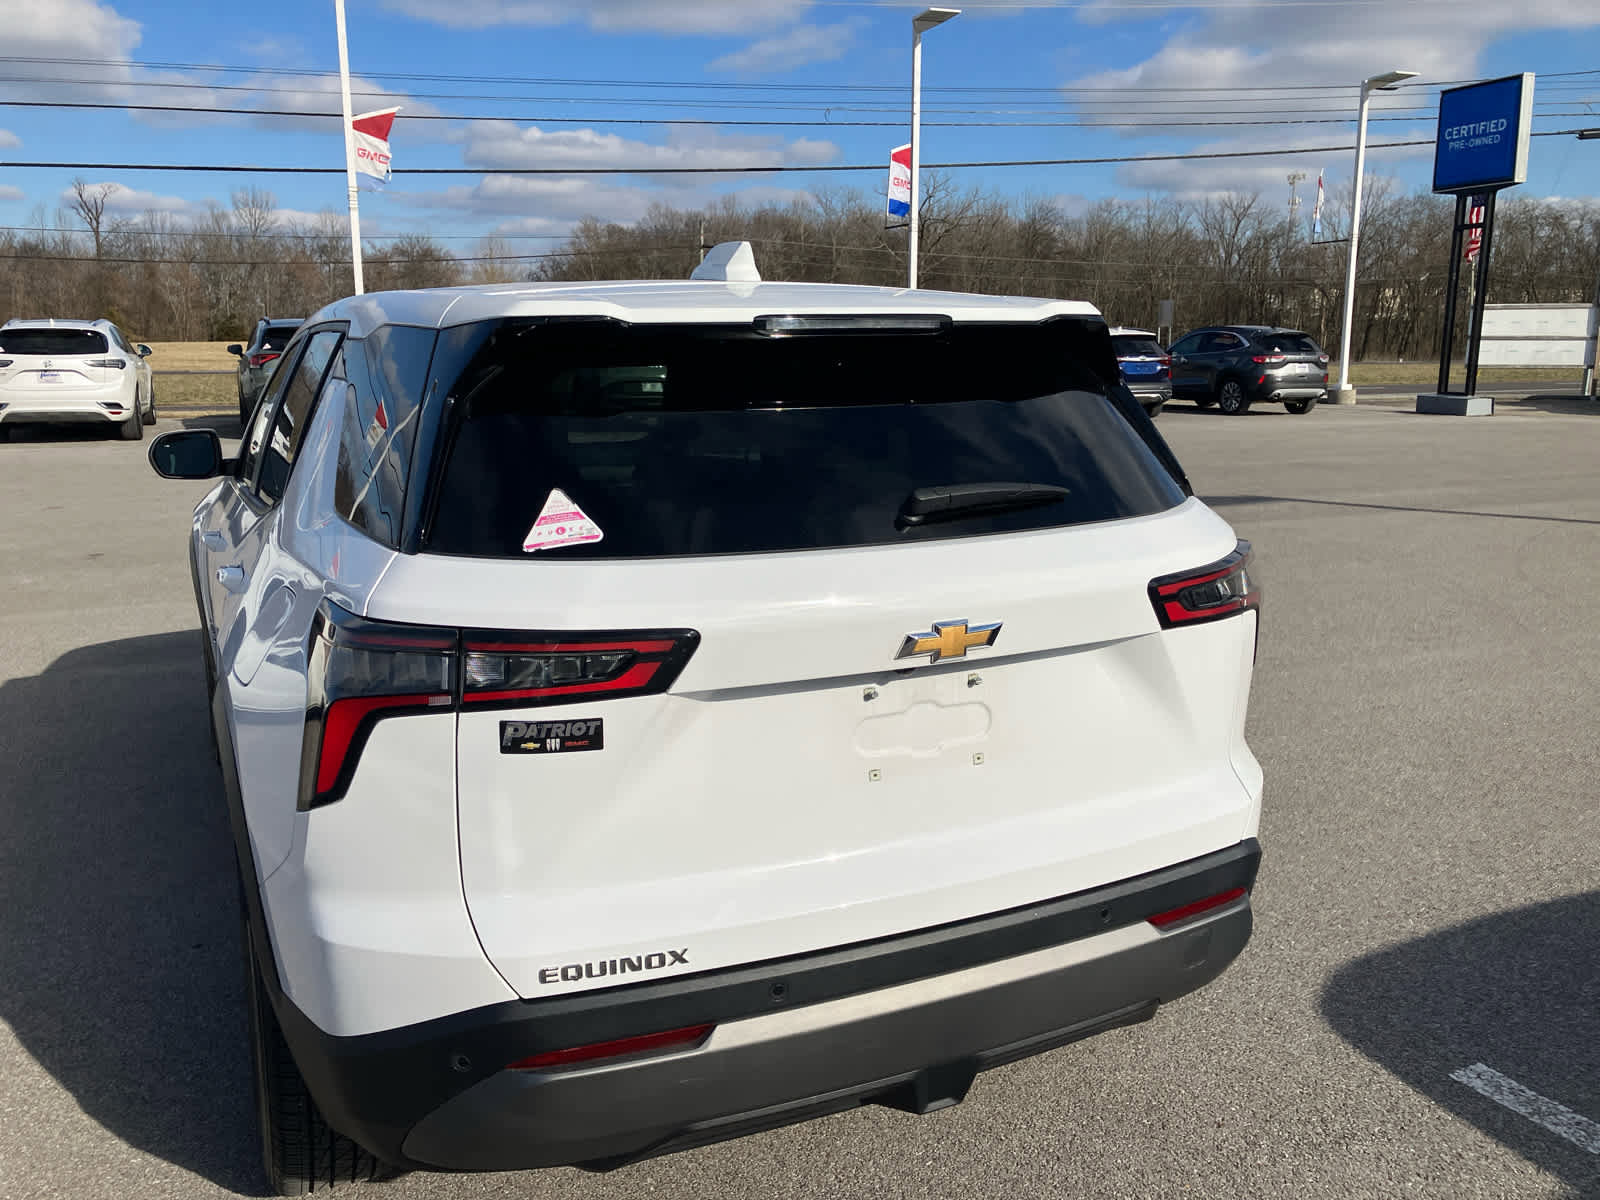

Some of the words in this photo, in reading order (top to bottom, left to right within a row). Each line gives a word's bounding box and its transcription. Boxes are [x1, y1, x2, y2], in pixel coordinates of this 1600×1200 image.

[1445, 118, 1507, 140] CERTIFIED
[1448, 134, 1501, 152] PRE-OWNED
[357, 147, 390, 165] GMC
[502, 721, 601, 747] PATRIOT
[538, 948, 689, 985] EQUINOX
